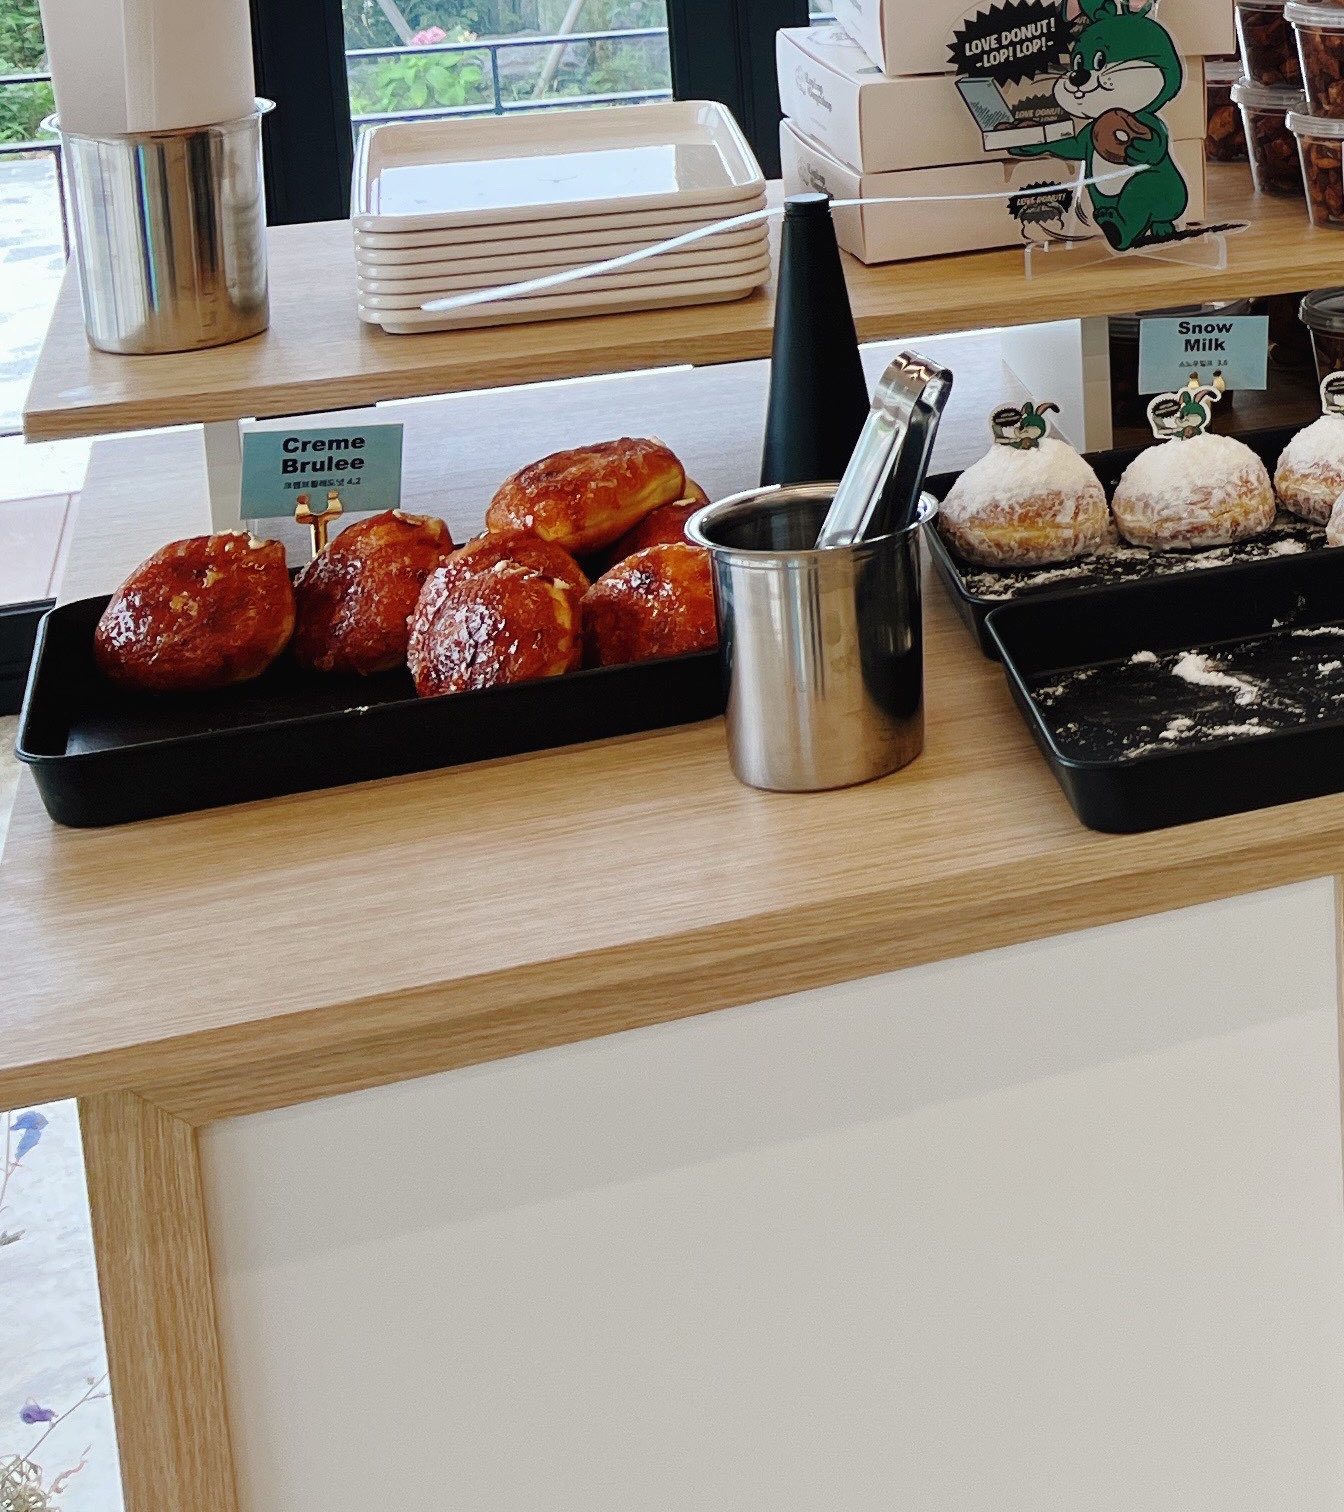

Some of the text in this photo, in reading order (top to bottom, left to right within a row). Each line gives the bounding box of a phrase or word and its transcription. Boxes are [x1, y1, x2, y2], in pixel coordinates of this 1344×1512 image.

[964, 17, 1056, 57] LOVE DONUT!
[975, 46, 1014, 68] -LOP!
[1178, 321, 1234, 335] Snow
[1184, 338, 1226, 353] Milk
[282, 437, 366, 454] Creme
[281, 455, 365, 475] Brulee
[346, 476, 362, 486] 4.2
